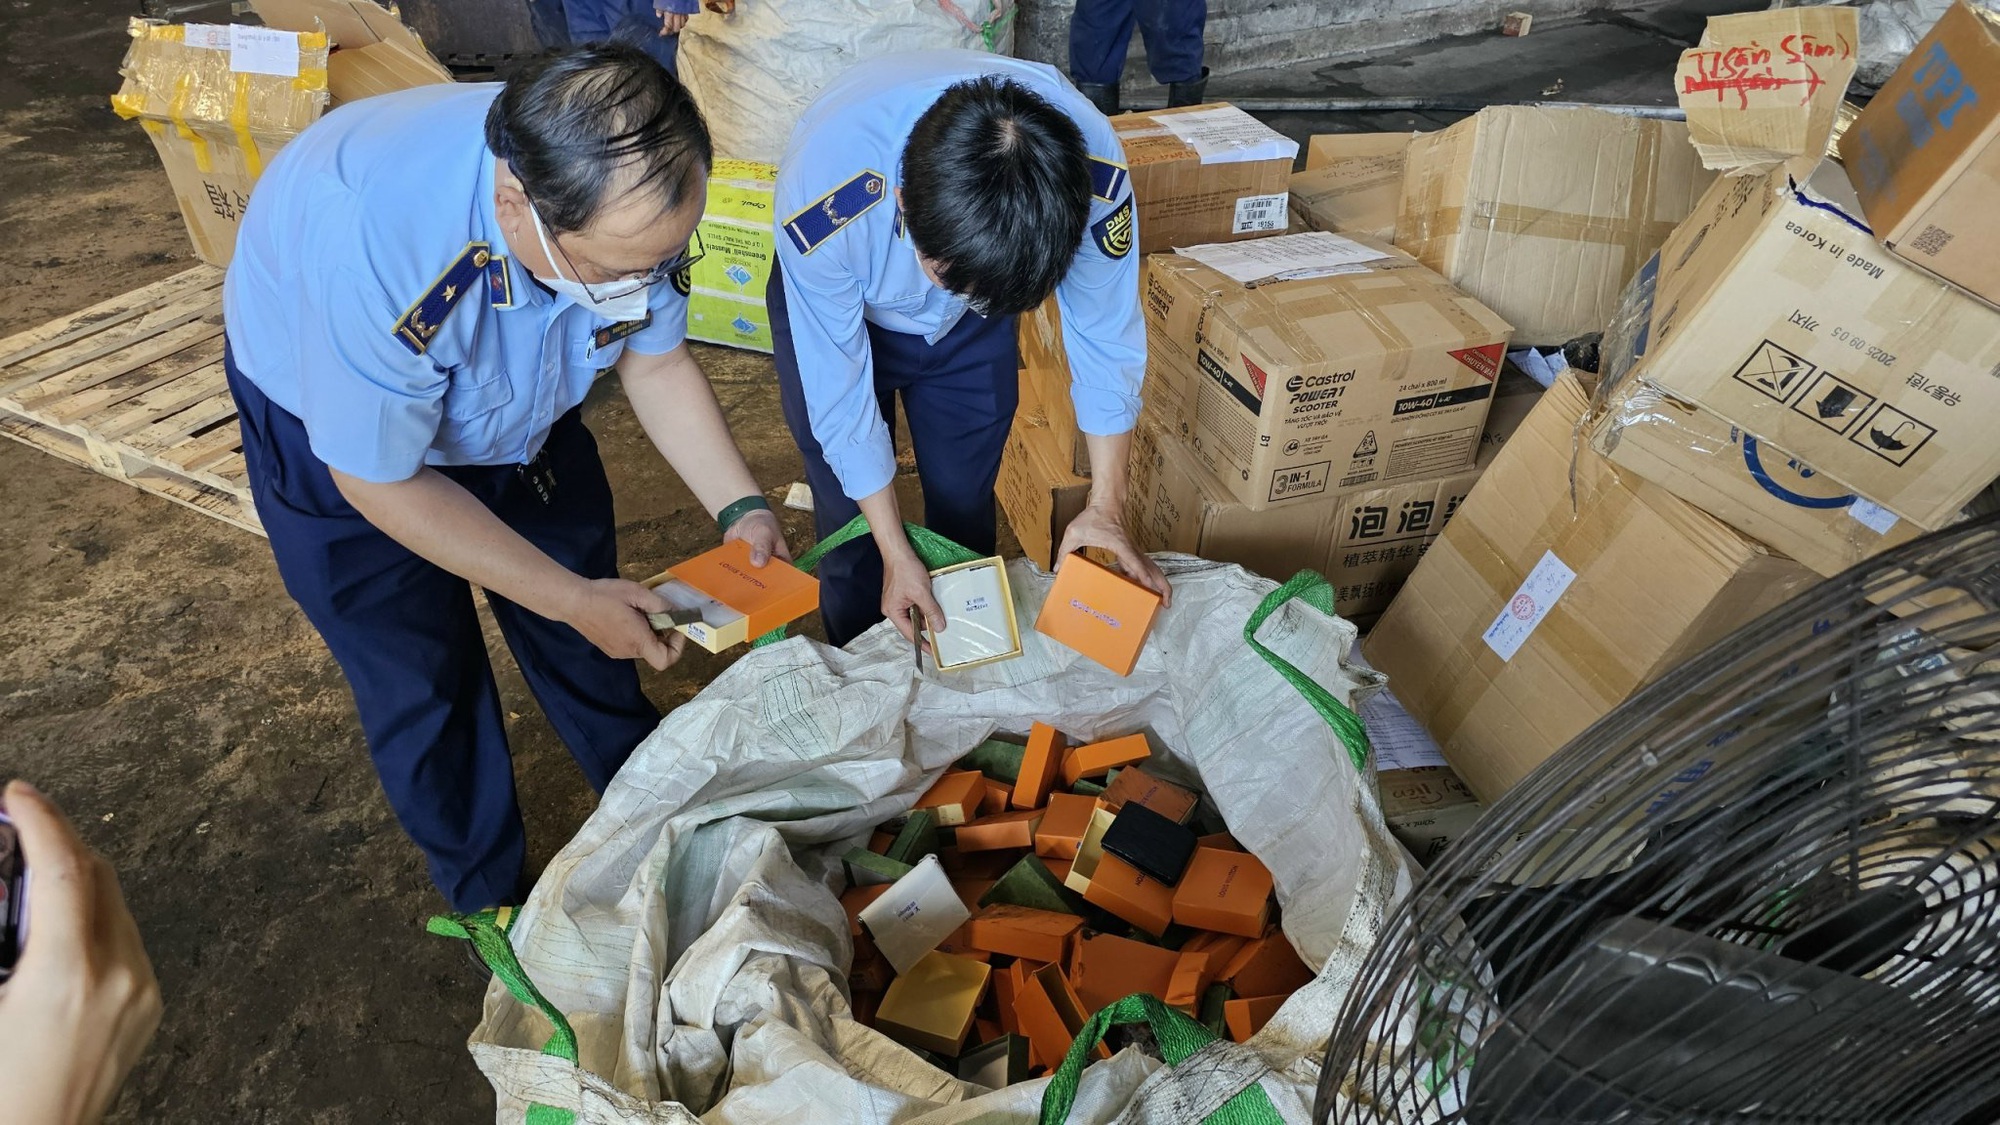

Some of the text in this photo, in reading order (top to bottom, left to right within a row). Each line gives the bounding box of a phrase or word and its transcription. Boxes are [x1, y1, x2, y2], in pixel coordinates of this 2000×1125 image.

[1105, 205, 1129, 230] DMS
[1785, 220, 1885, 280] Made in Korea
[1788, 309, 1962, 407] 유통기한 2025.09.05 까지
[1305, 369, 1356, 388] Castrol
[1407, 382, 1421, 391] chai
[1289, 385, 1346, 404] POWER1
[1293, 400, 1338, 414] SCOOTER
[1398, 398, 1433, 412] 10W-40
[1260, 435, 1270, 447] B1
[1275, 470, 1311, 495] 3 IN-1
[1287, 480, 1321, 493] FORMULA
